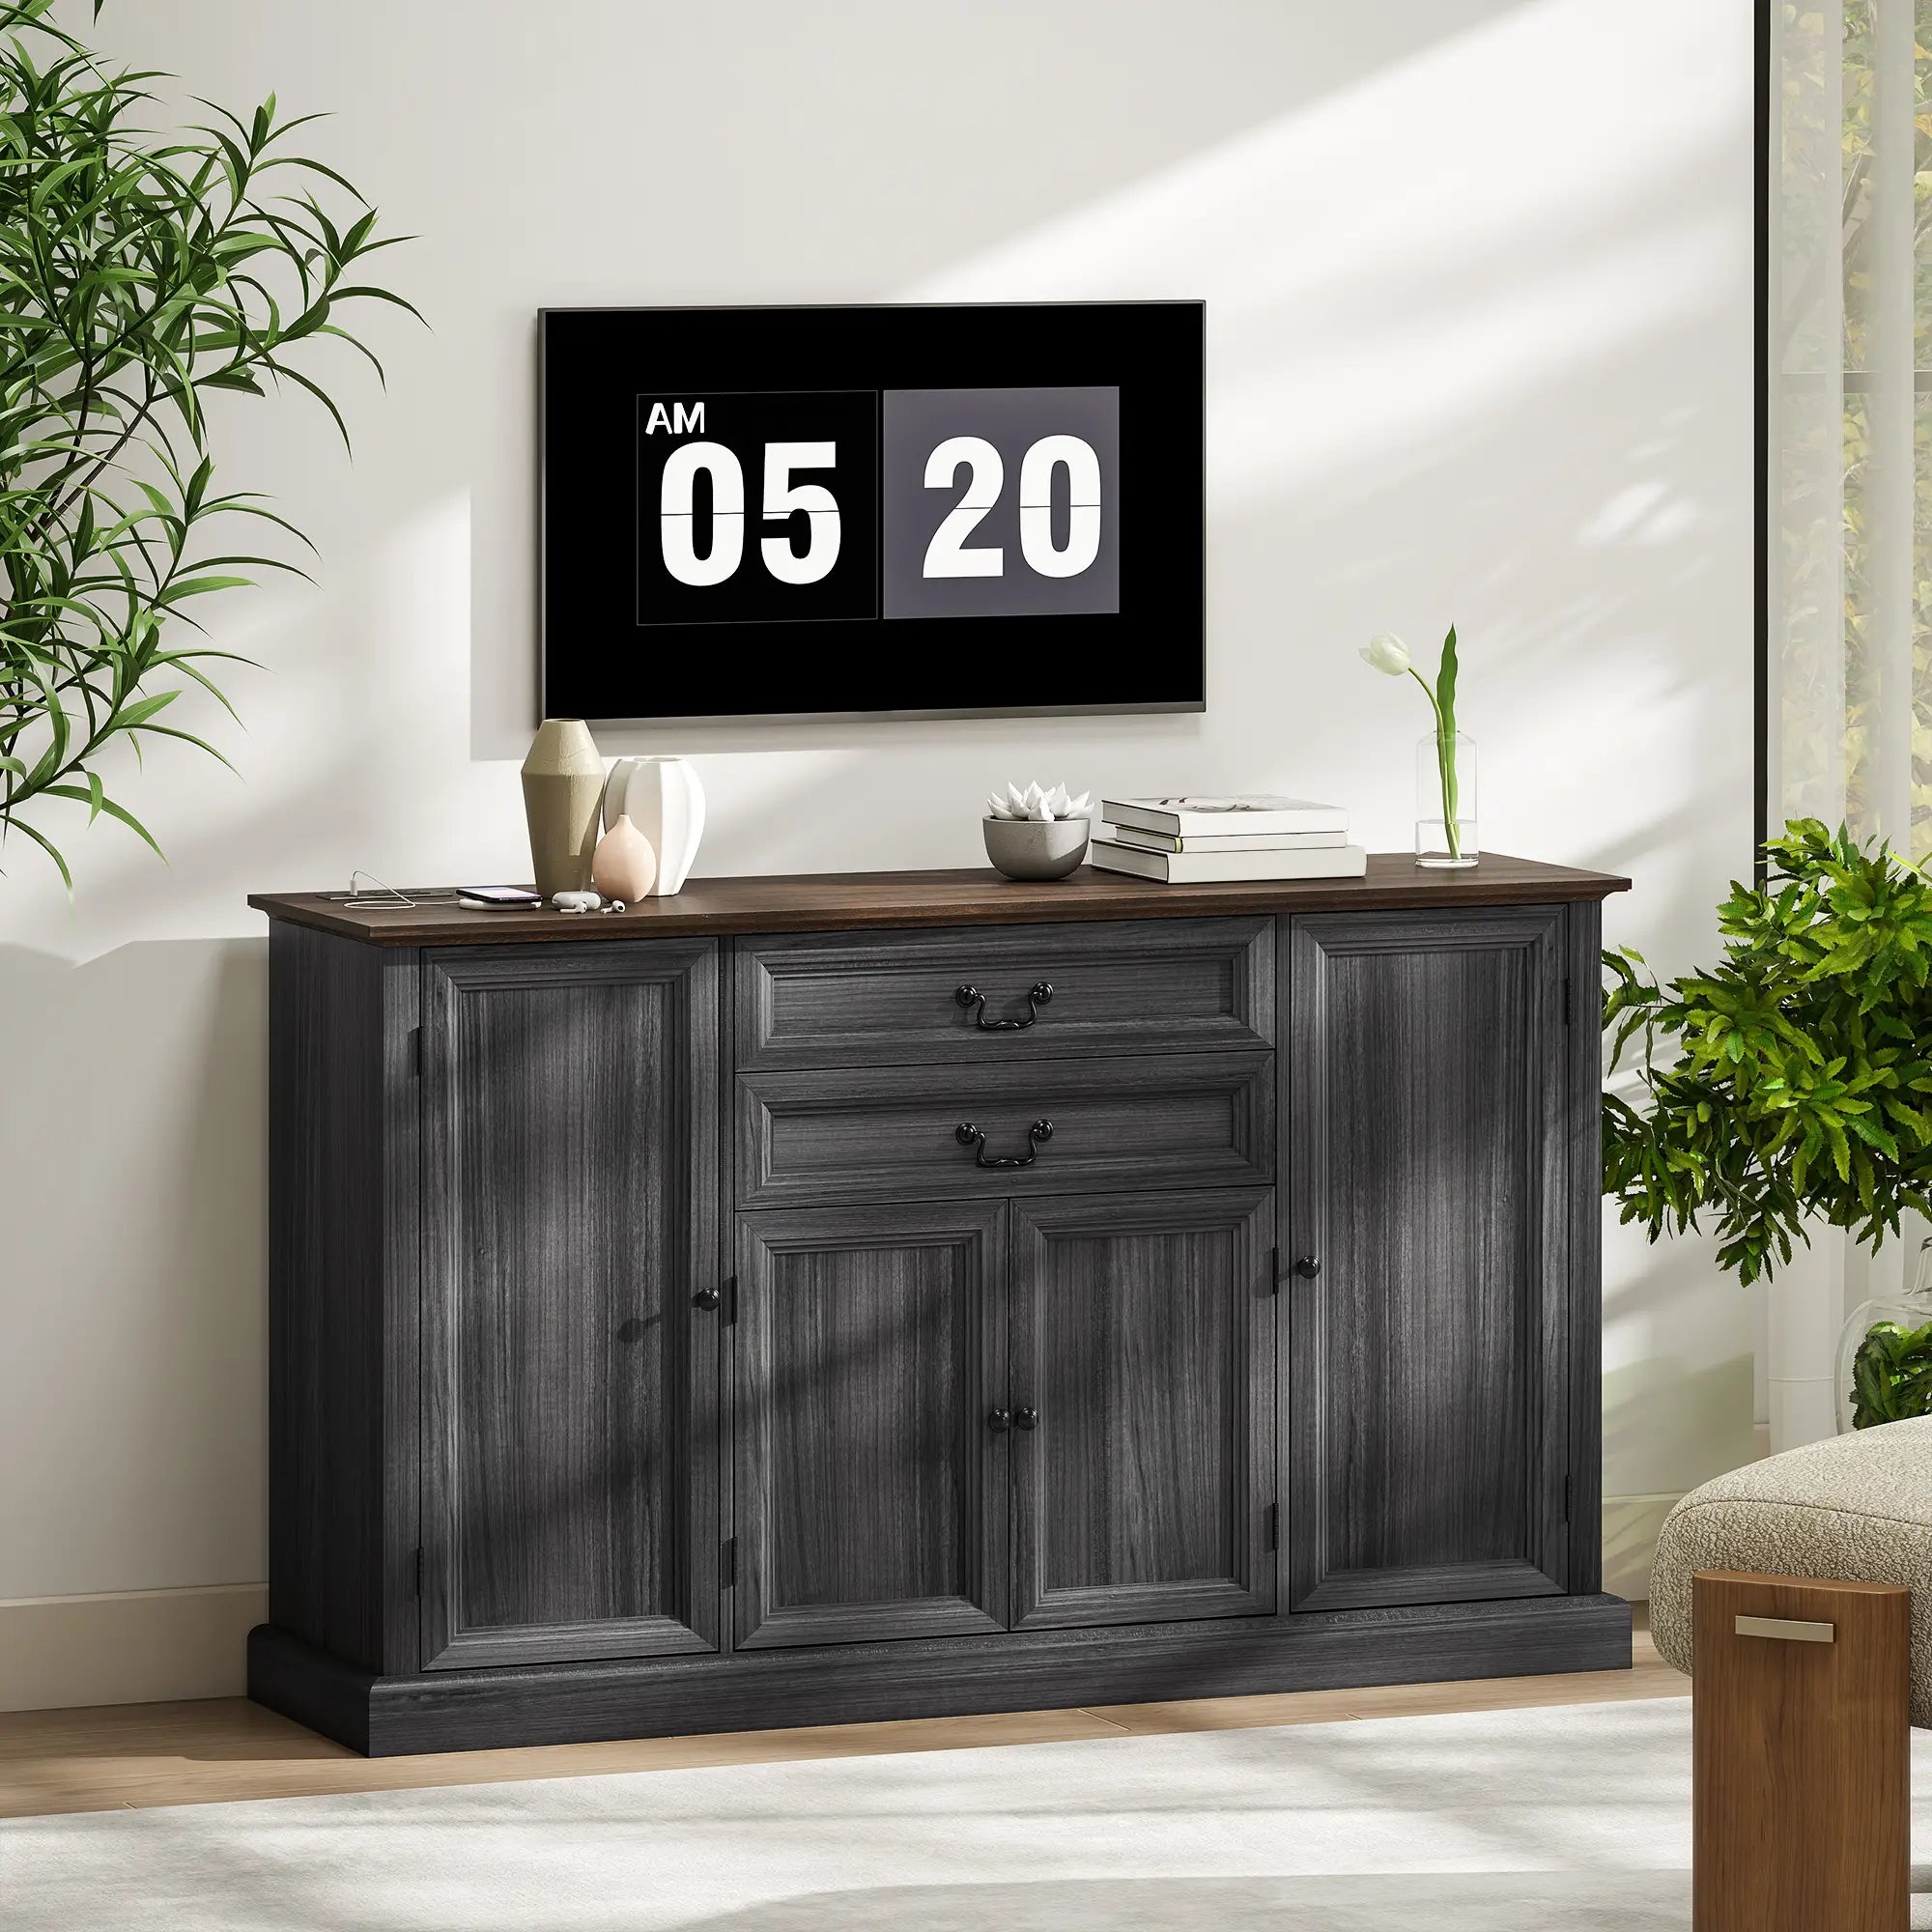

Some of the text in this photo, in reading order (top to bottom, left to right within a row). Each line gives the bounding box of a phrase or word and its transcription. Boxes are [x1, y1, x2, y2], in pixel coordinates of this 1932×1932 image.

[645, 402, 705, 435] AM
[661, 435, 1101, 586] 05 20
